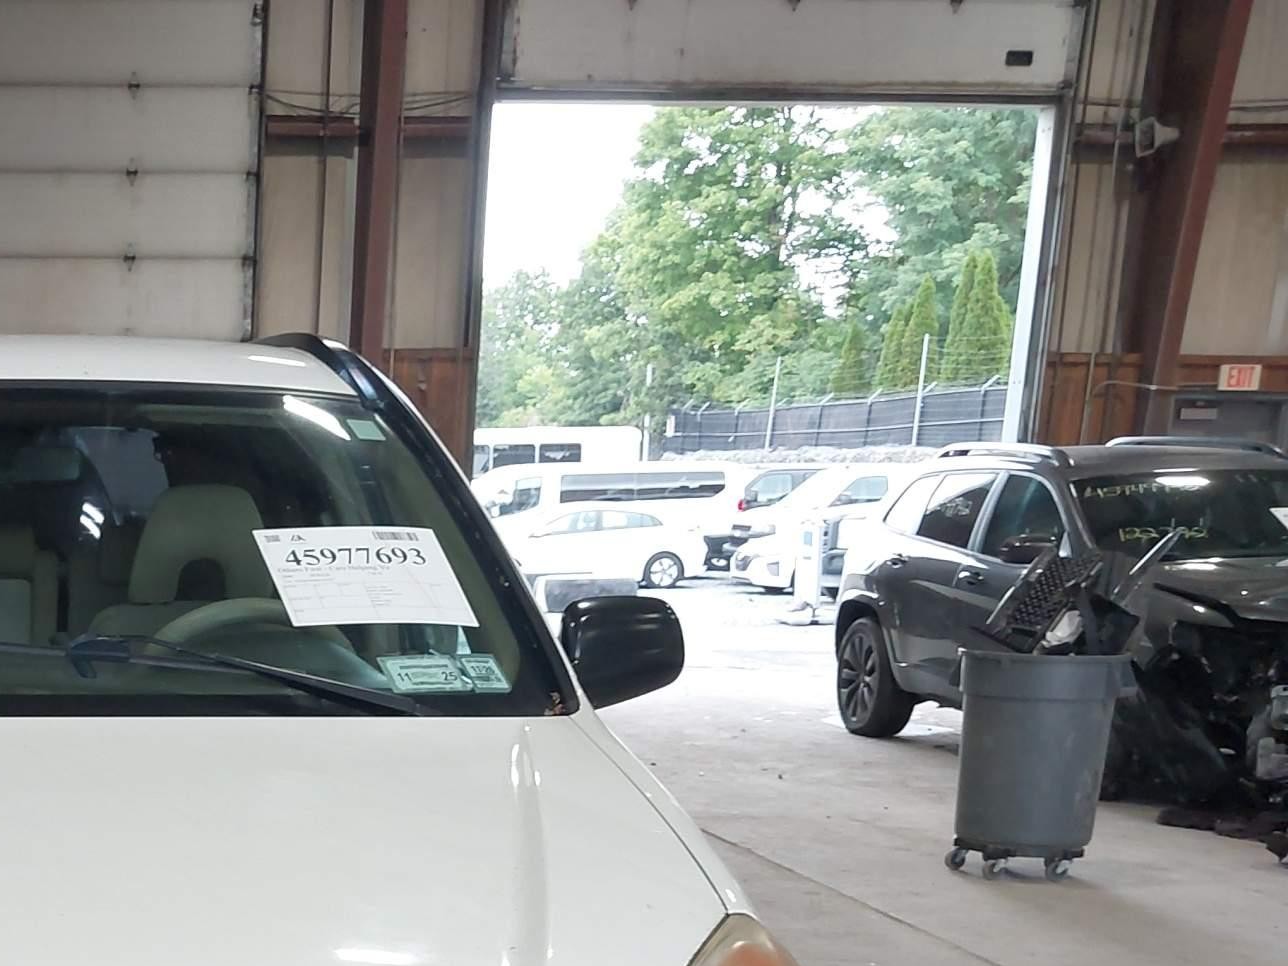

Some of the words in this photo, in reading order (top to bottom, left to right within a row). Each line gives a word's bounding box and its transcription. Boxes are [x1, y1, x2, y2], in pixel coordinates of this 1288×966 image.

[1226, 366, 1255, 388] EXIT
[285, 546, 427, 566] 45977693
[397, 672, 412, 682] 11
[441, 671, 458, 681] 25
